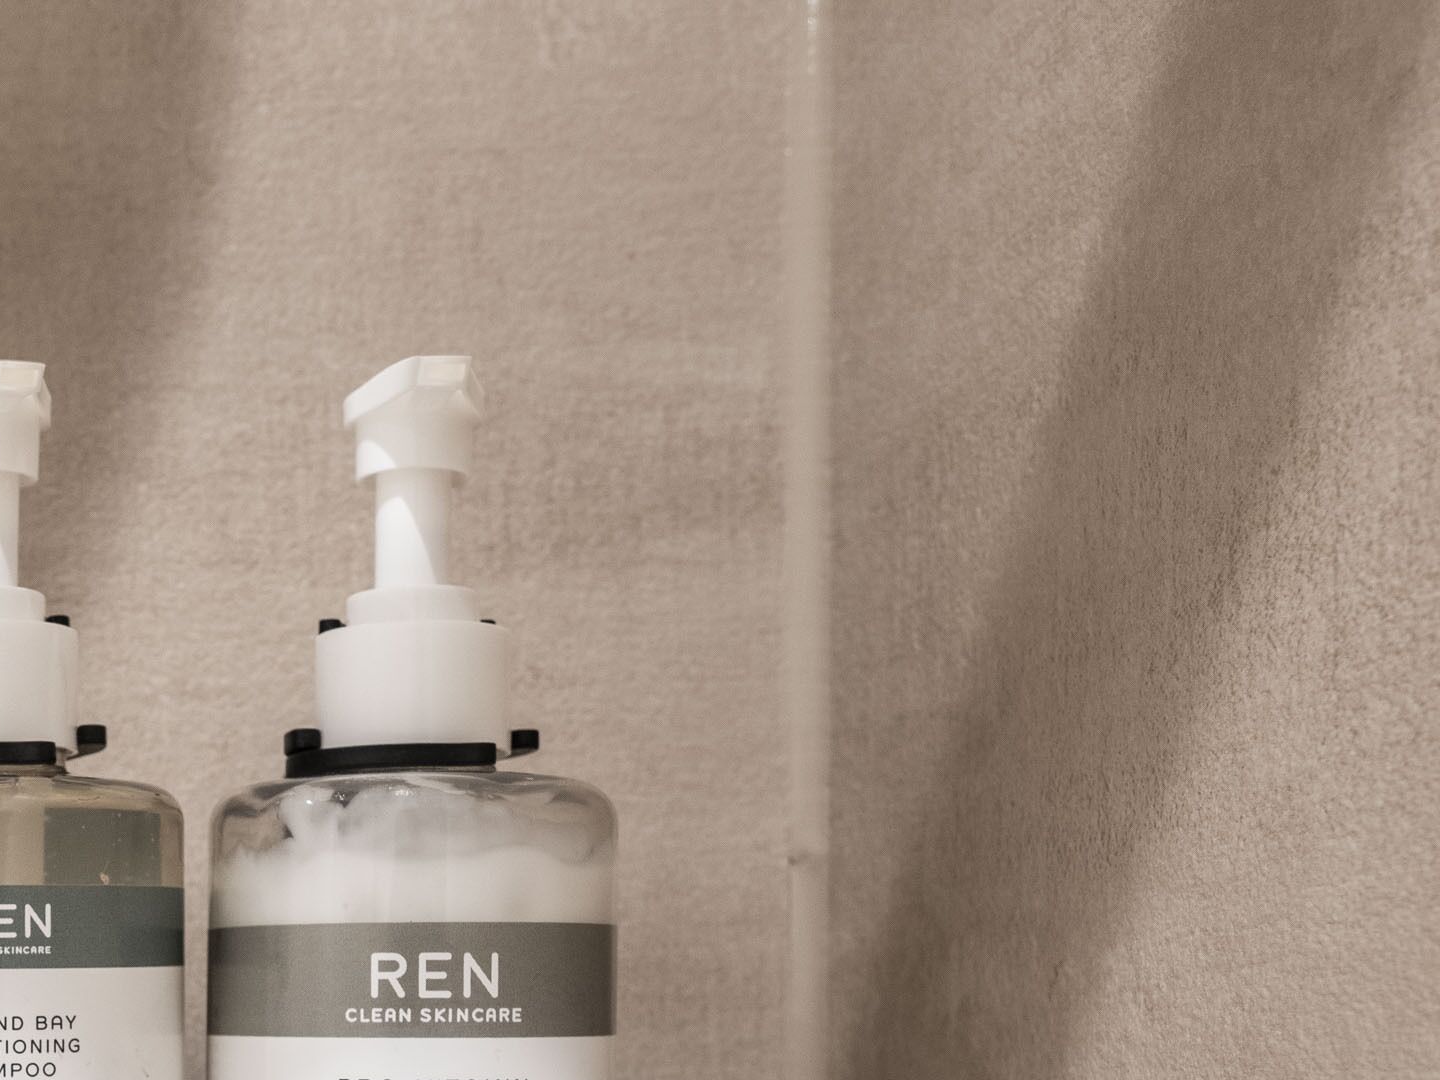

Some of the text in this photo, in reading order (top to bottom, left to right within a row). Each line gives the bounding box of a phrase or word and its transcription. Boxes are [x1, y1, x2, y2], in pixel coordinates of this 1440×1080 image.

[370, 952, 499, 999] REN
[35, 1015, 77, 1031] BAY
[345, 1007, 523, 1024] CLEAN SKINCARE
